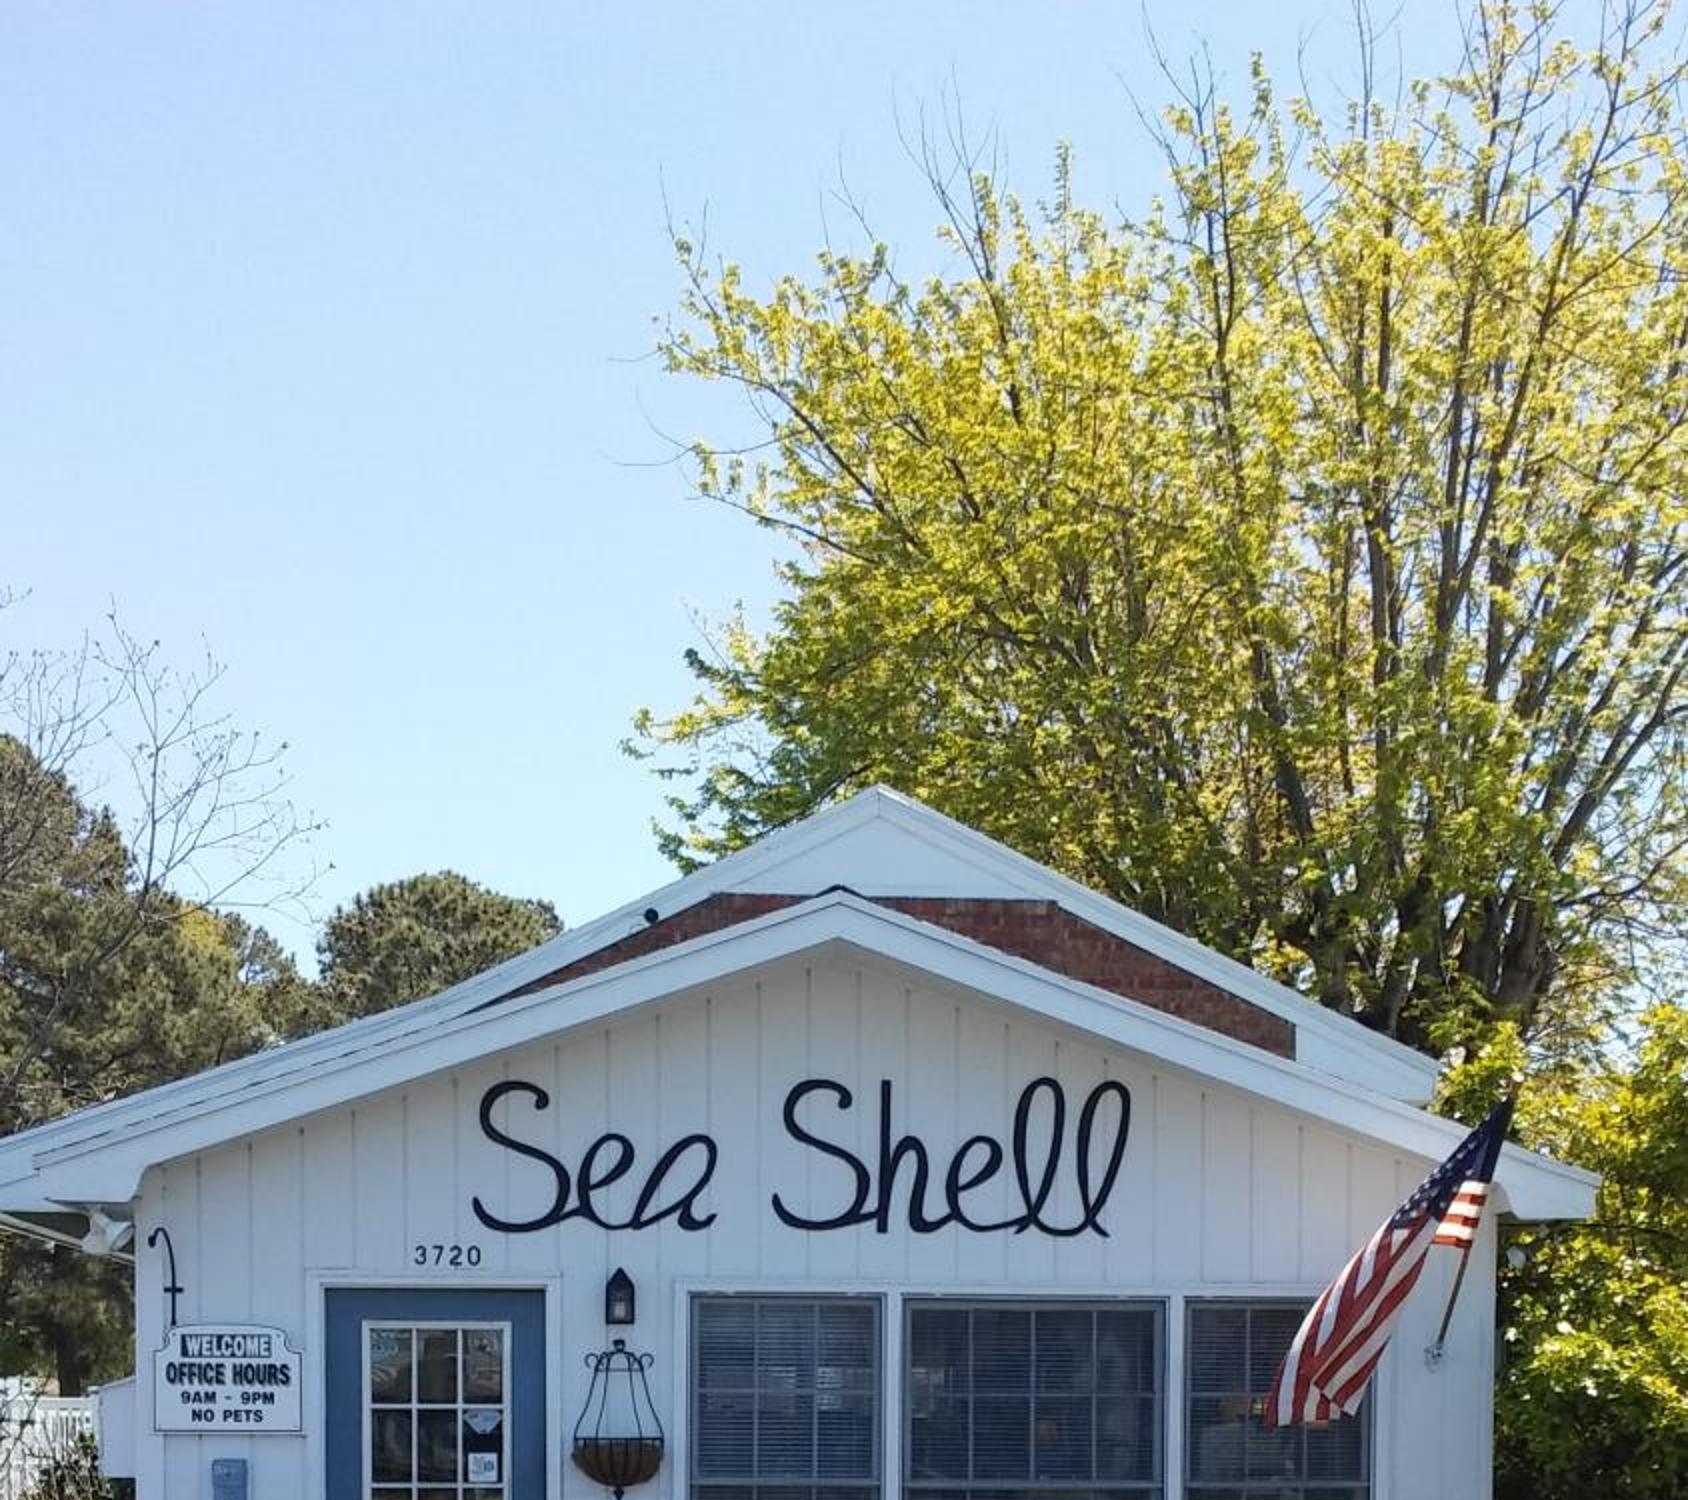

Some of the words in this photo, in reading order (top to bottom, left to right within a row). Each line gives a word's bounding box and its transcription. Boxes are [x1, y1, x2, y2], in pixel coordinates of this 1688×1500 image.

[472, 1080, 718, 1233] Sea
[771, 1076, 1131, 1238] Shell
[414, 1244, 482, 1267] 3720
[184, 1334, 271, 1358] WELCOME
[165, 1361, 226, 1387] OFFICE
[232, 1362, 291, 1387] HOURS
[180, 1391, 217, 1405] 9AM
[240, 1391, 275, 1405] 9PM
[191, 1409, 215, 1422] NO
[222, 1409, 264, 1422] PETS
